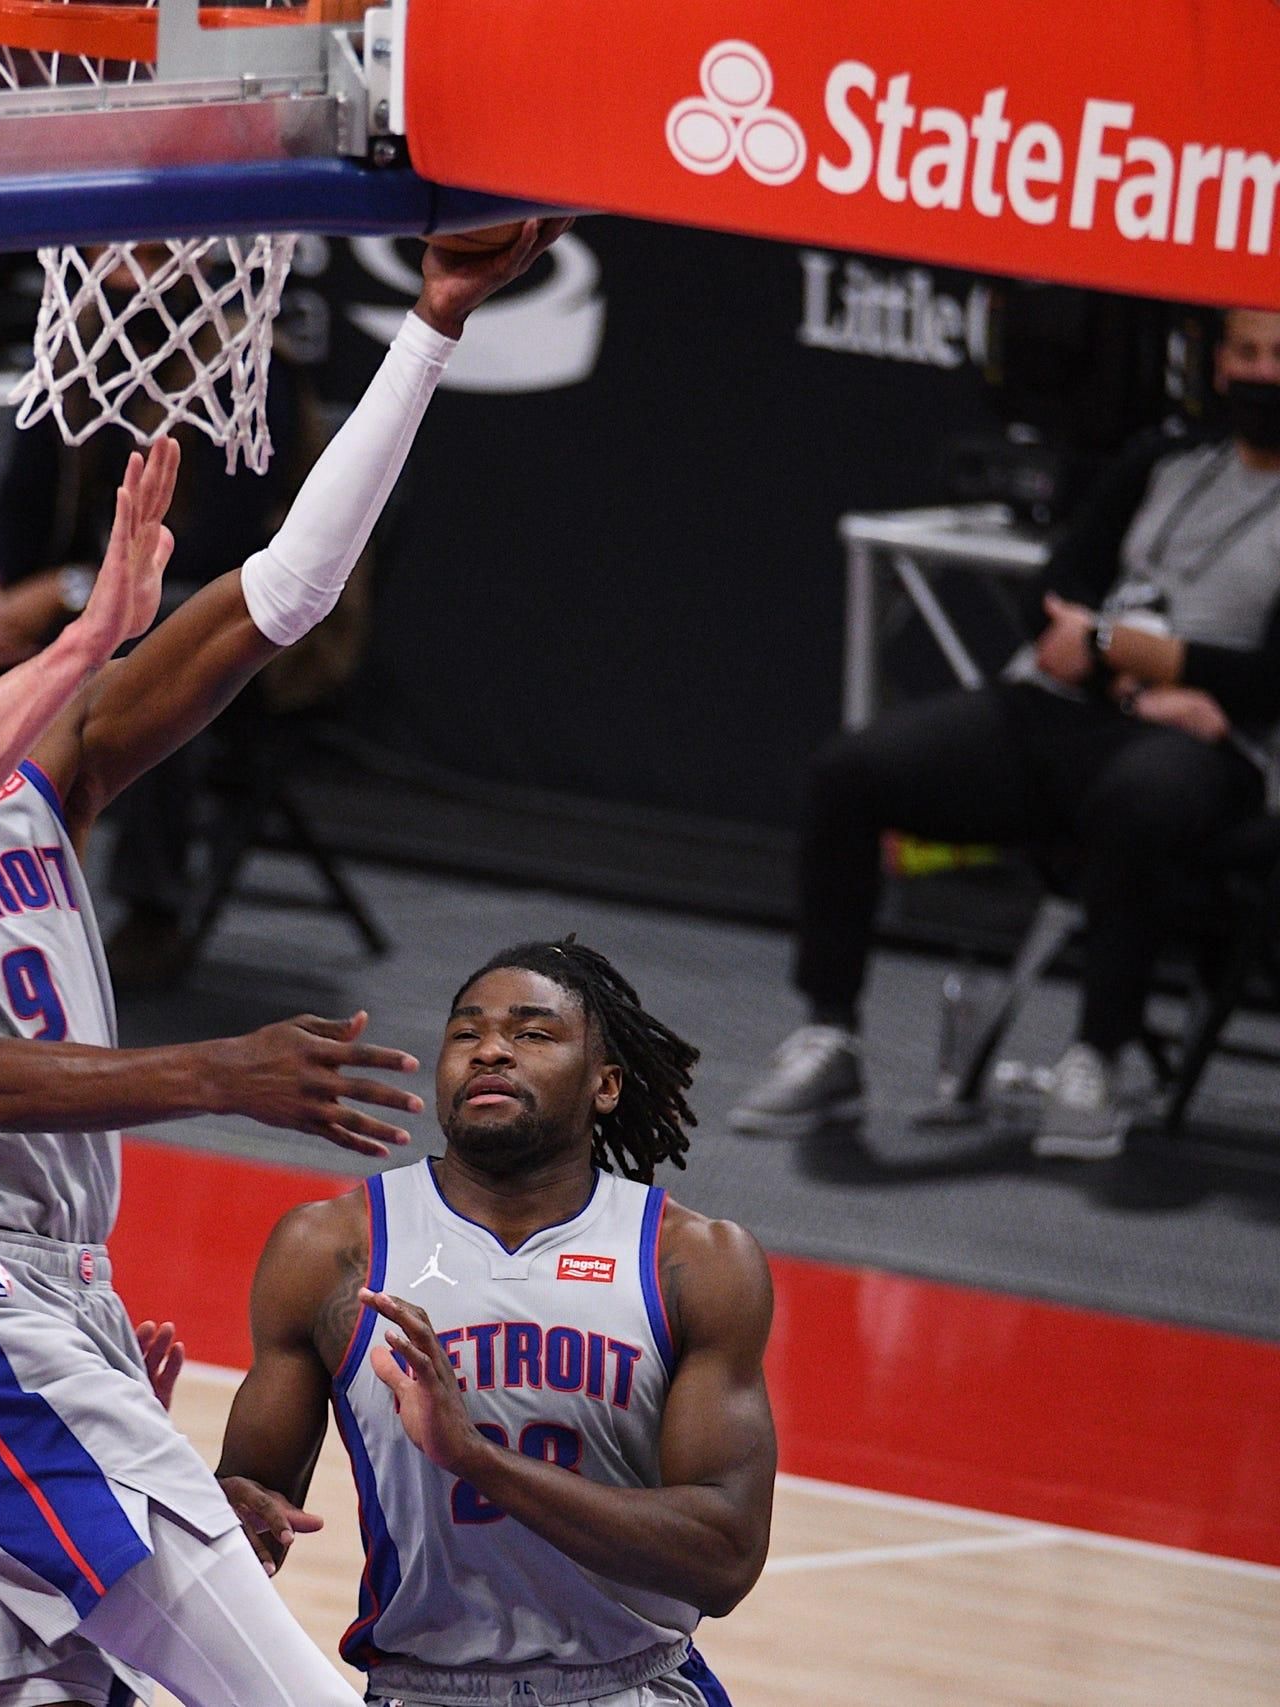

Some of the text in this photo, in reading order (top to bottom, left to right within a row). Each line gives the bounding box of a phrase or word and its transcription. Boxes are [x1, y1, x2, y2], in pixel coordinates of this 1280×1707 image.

[797, 250, 964, 369] Little
[1, 946, 68, 1042] 9
[561, 1258, 613, 1272] Flagstar
[388, 1321, 642, 1412] ETROIT
